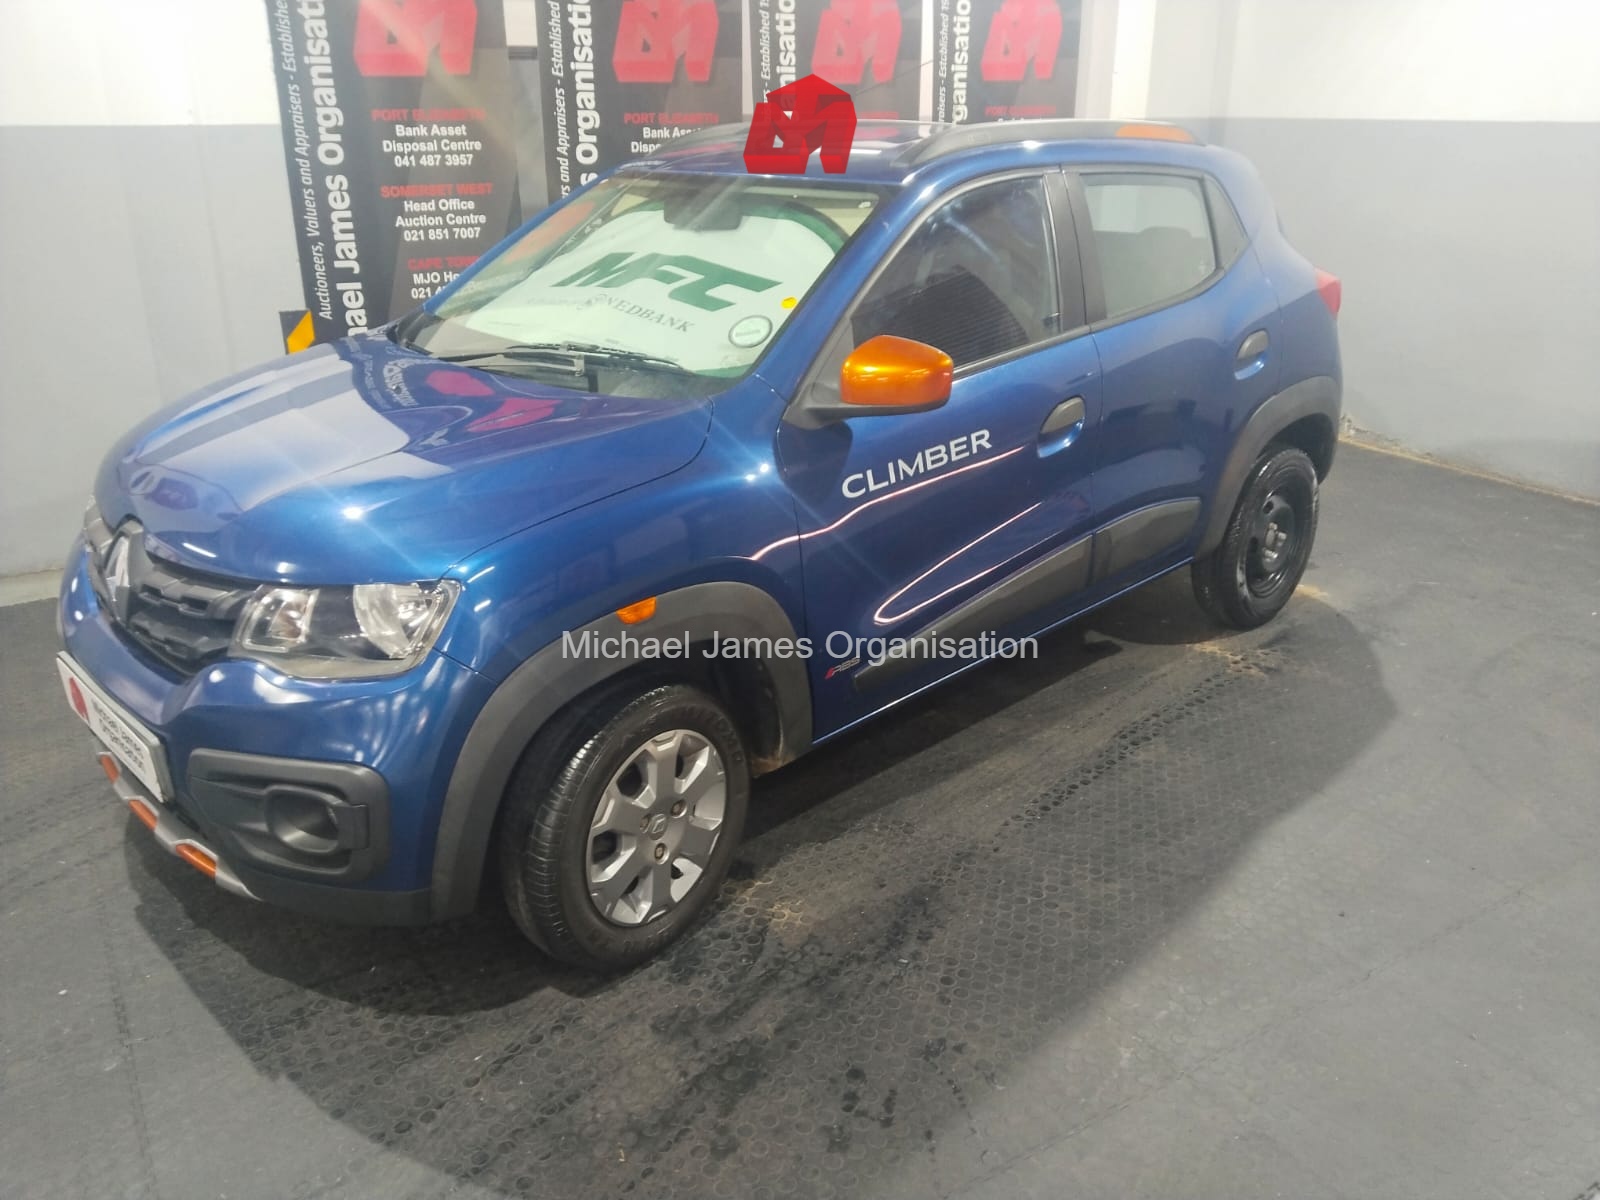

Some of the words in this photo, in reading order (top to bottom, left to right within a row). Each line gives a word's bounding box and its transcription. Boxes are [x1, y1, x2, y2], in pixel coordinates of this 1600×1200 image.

[274, 0, 297, 72] Establishe
[547, 0, 564, 77] Established
[759, 9, 771, 80] Established
[297, 0, 344, 166] Organisat
[567, 0, 600, 165] Organisati
[287, 84, 311, 156] Appraisers
[395, 124, 428, 137] Bank
[430, 124, 467, 136] Asset
[553, 87, 571, 156] Appraisers
[643, 127, 670, 139] Bank
[382, 139, 438, 154] Disposal
[441, 139, 482, 151] Centre
[394, 155, 416, 167] 041
[419, 154, 441, 166] 487
[445, 154, 473, 166] 3957
[295, 158, 313, 184] and
[556, 157, 571, 183] and
[303, 189, 320, 237] Valuers
[395, 215, 443, 228] Auction
[446, 213, 487, 225] Centre
[404, 200, 436, 212] Head
[439, 198, 475, 211] Office
[325, 174, 360, 274] James
[403, 229, 425, 241] 021
[428, 228, 449, 240] 851
[452, 227, 481, 239] 7007
[311, 242, 333, 320] Auctioneers,
[411, 287, 432, 299] 021
[412, 272, 440, 285] MJO
[842, 428, 993, 499] CLIMBER
